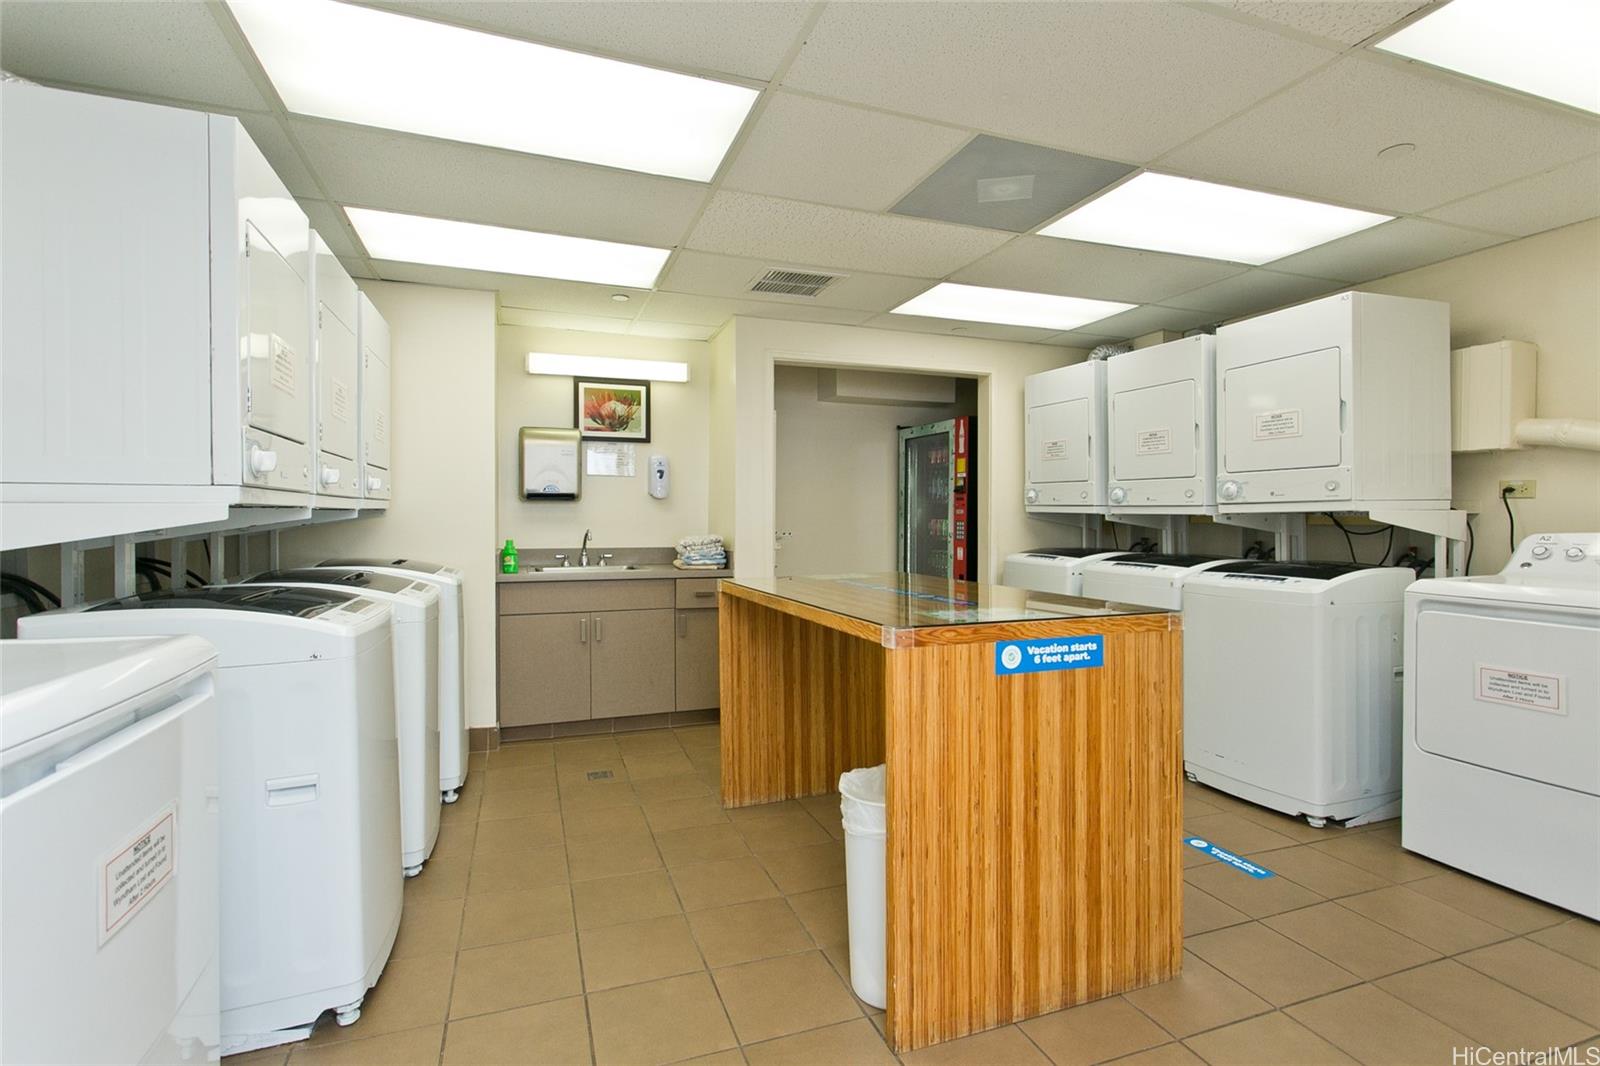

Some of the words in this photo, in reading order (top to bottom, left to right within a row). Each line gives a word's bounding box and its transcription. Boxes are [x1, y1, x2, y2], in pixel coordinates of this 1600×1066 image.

[1027, 643, 1069, 655] Vacation
[1070, 643, 1098, 651] starts
[1034, 655, 1042, 664] 6
[1042, 654, 1062, 663] feet
[1063, 652, 1091, 663] apart.
[133, 835, 151, 855] NOTICE
